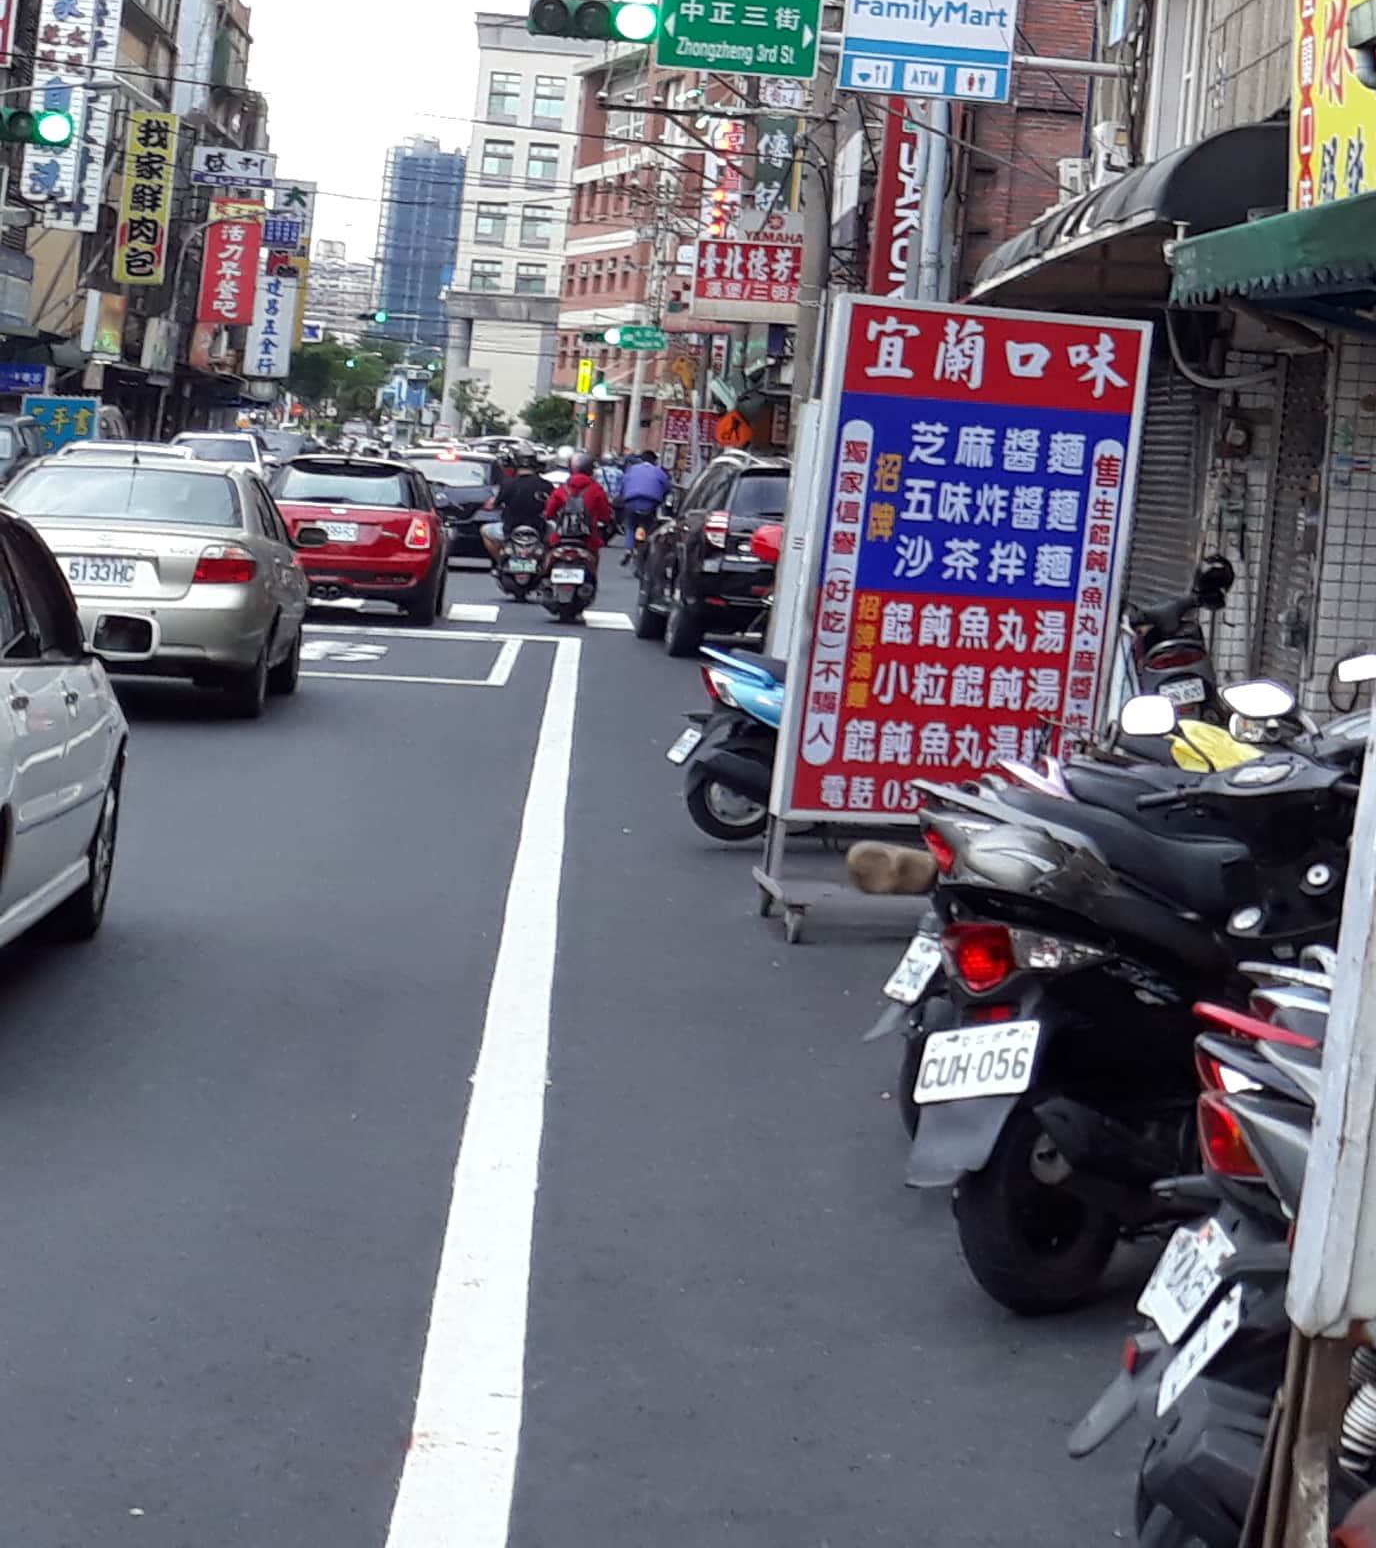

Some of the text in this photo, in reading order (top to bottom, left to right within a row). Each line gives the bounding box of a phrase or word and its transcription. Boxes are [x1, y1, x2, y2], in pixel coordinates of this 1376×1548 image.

[676, 36, 753, 66] Zhongzheng
[757, 44, 778, 63] 3rd
[909, 68, 940, 88] ATM
[124, 118, 170, 278] 我家鮮肉包
[744, 230, 803, 245] YAMAHA
[700, 243, 802, 283] 臺北德芳
[864, 316, 1129, 398] 宜蘭口味
[893, 534, 1074, 588] 沙茶拌麵
[881, 601, 1067, 654] 餛飩魚丸湯
[873, 659, 1062, 712] 小粒餛飩湯
[820, 774, 876, 810] 電話
